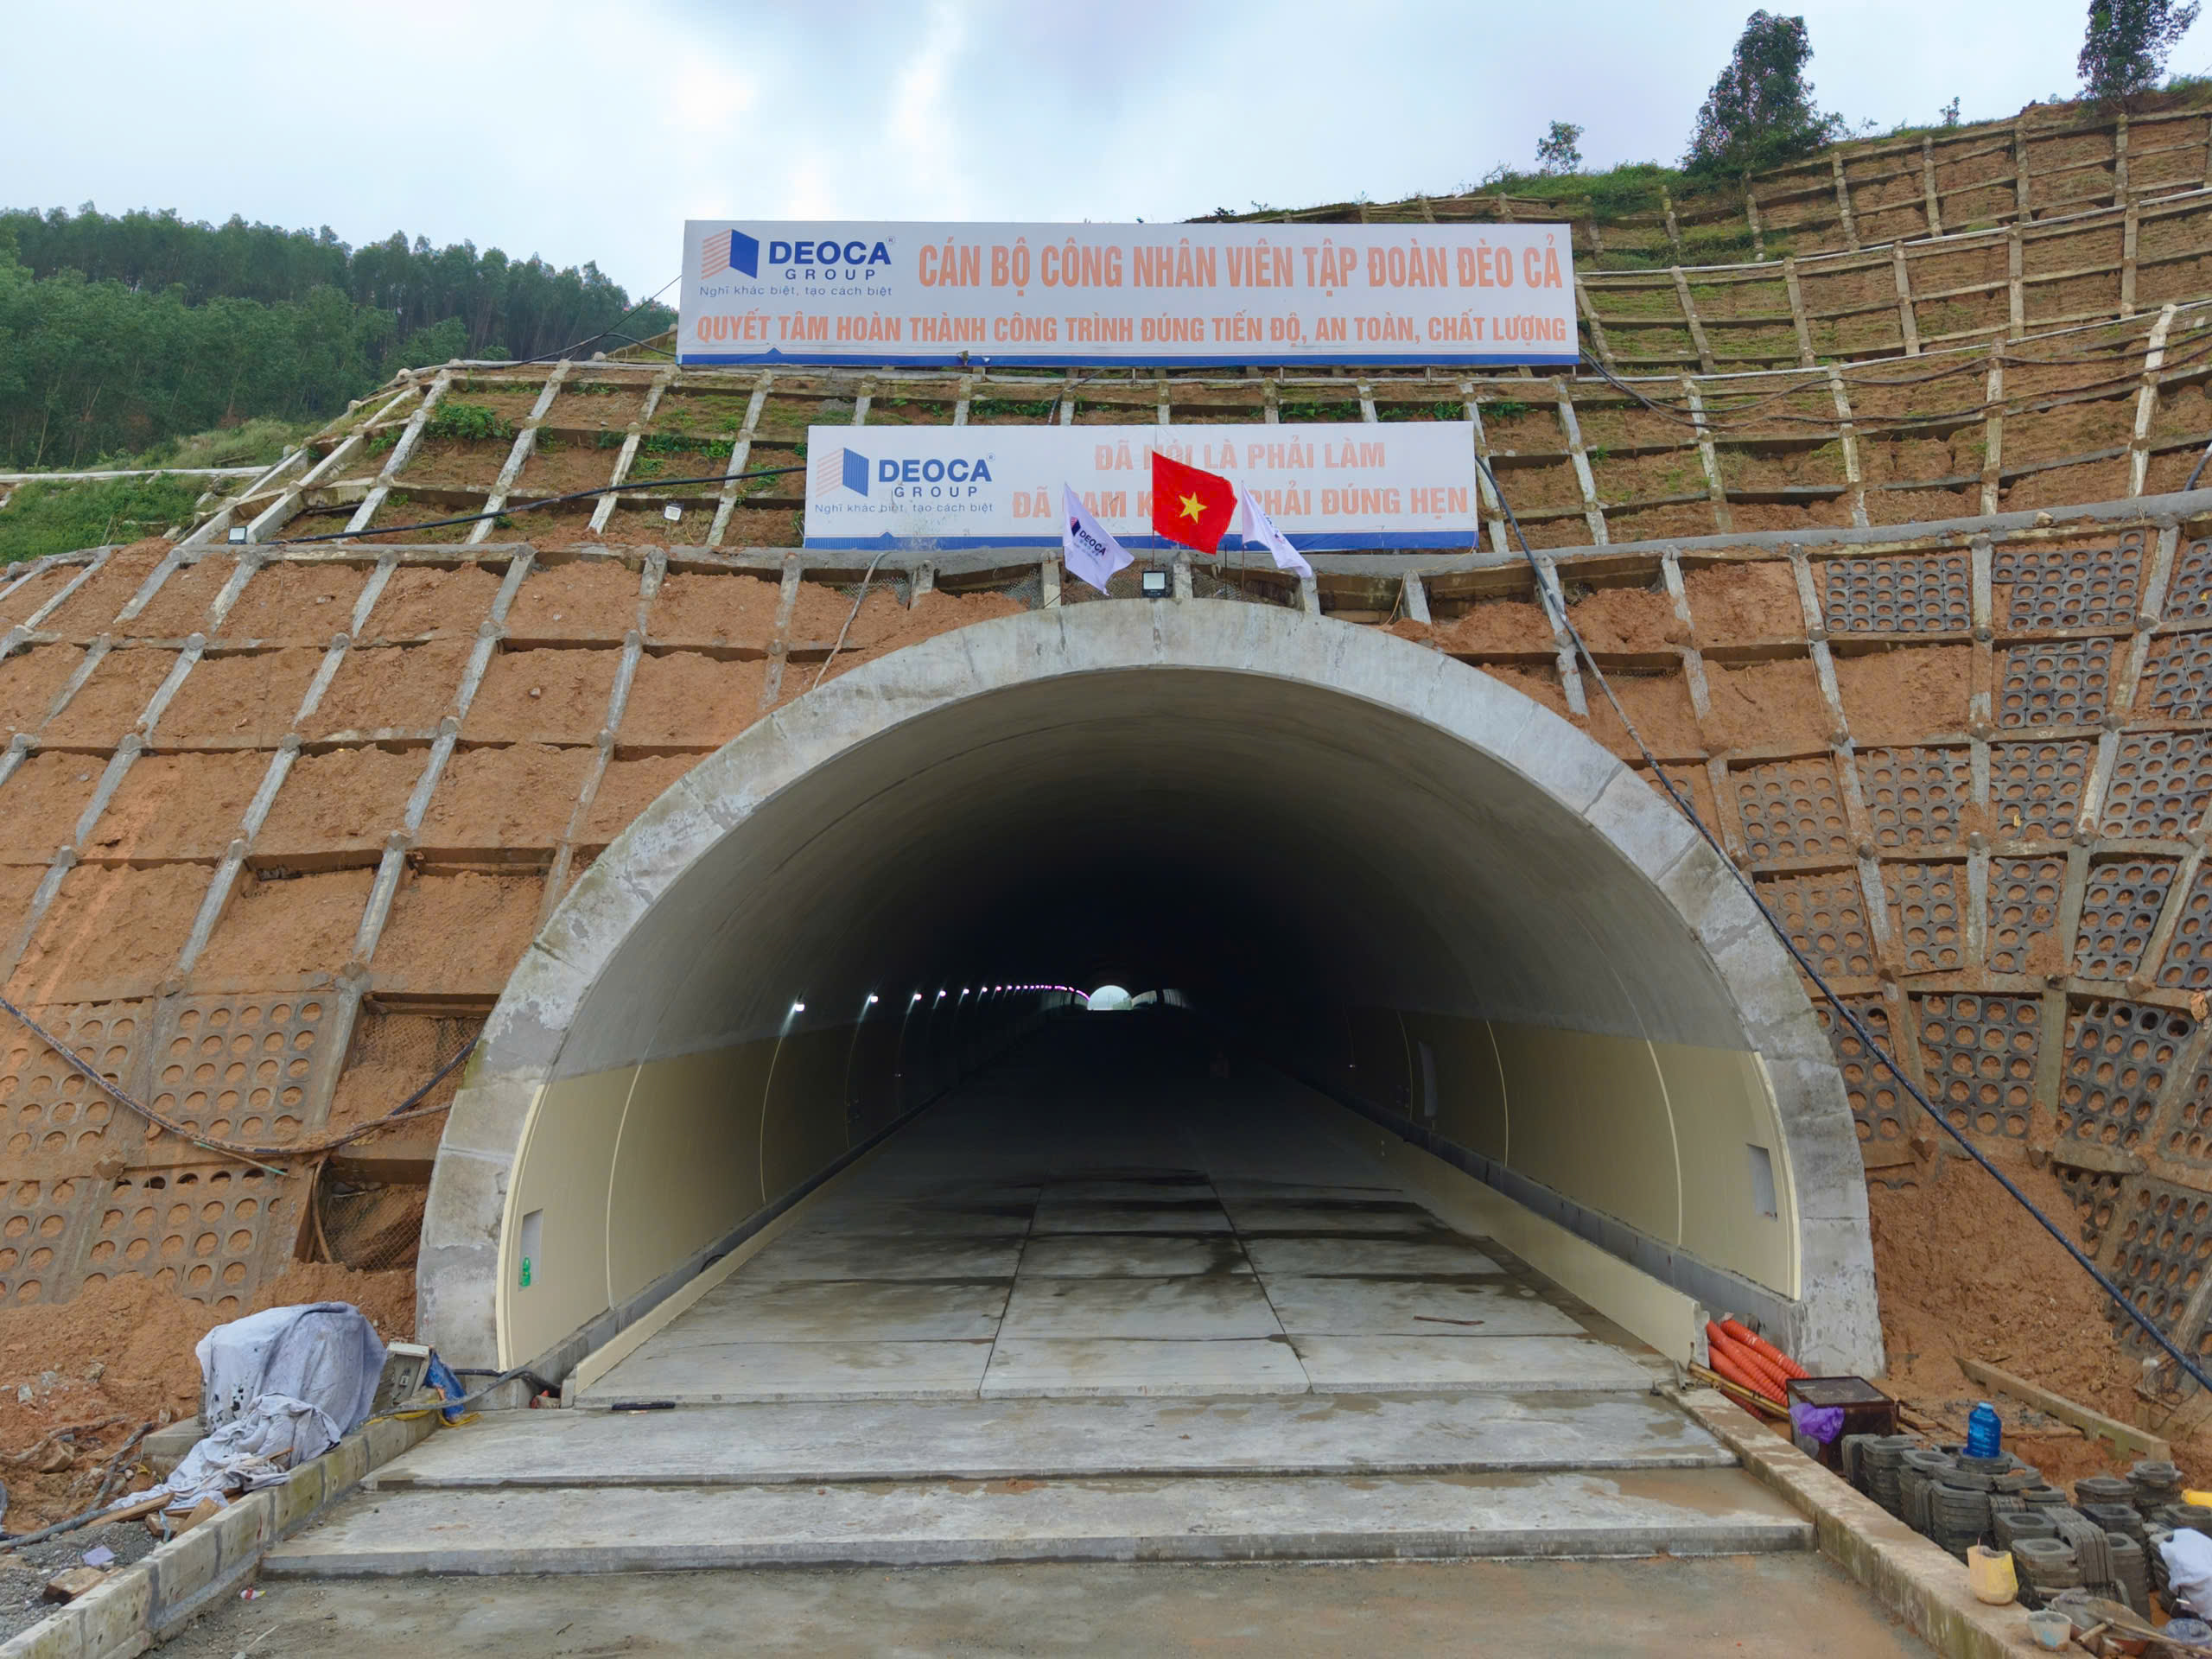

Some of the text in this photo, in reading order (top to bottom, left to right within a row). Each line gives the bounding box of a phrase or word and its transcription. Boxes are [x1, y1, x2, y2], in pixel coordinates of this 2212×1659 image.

[768, 240, 892, 265] DEOCA
[918, 232, 1563, 297] CÁN BỘ CÔNG NHÂN VIÊN TẬP ĐOÀN ĐÈO CẢ
[785, 268, 875, 281] GROUP
[699, 286, 893, 298] Nghĩ khác biệt, tạo cách biệt
[697, 307, 1567, 347] QUYẾT TÂM HOÀN THÀNH CÔNG TRÌNH ĐÚNG TIẾN ĐỘ, AN TOÀN, CHẤT LƯỢNG
[1094, 438, 1133, 471] ĐÃ
[1204, 438, 1238, 470] LÀ
[1247, 435, 1314, 469] PHẢI
[1324, 436, 1386, 469] LÀM
[878, 458, 993, 483] DEOCA
[893, 486, 978, 498] GROUP
[1012, 485, 1052, 518] ĐÃ
[1062, 490, 1127, 518] AM
[1321, 482, 1402, 515] ĐÚNG
[1410, 486, 1468, 520] HẸN
[815, 503, 843, 515] Nghĩ
[937, 503, 965, 512] cách
[970, 503, 994, 513] biệt
[1078, 530, 1107, 556] DEOCA
